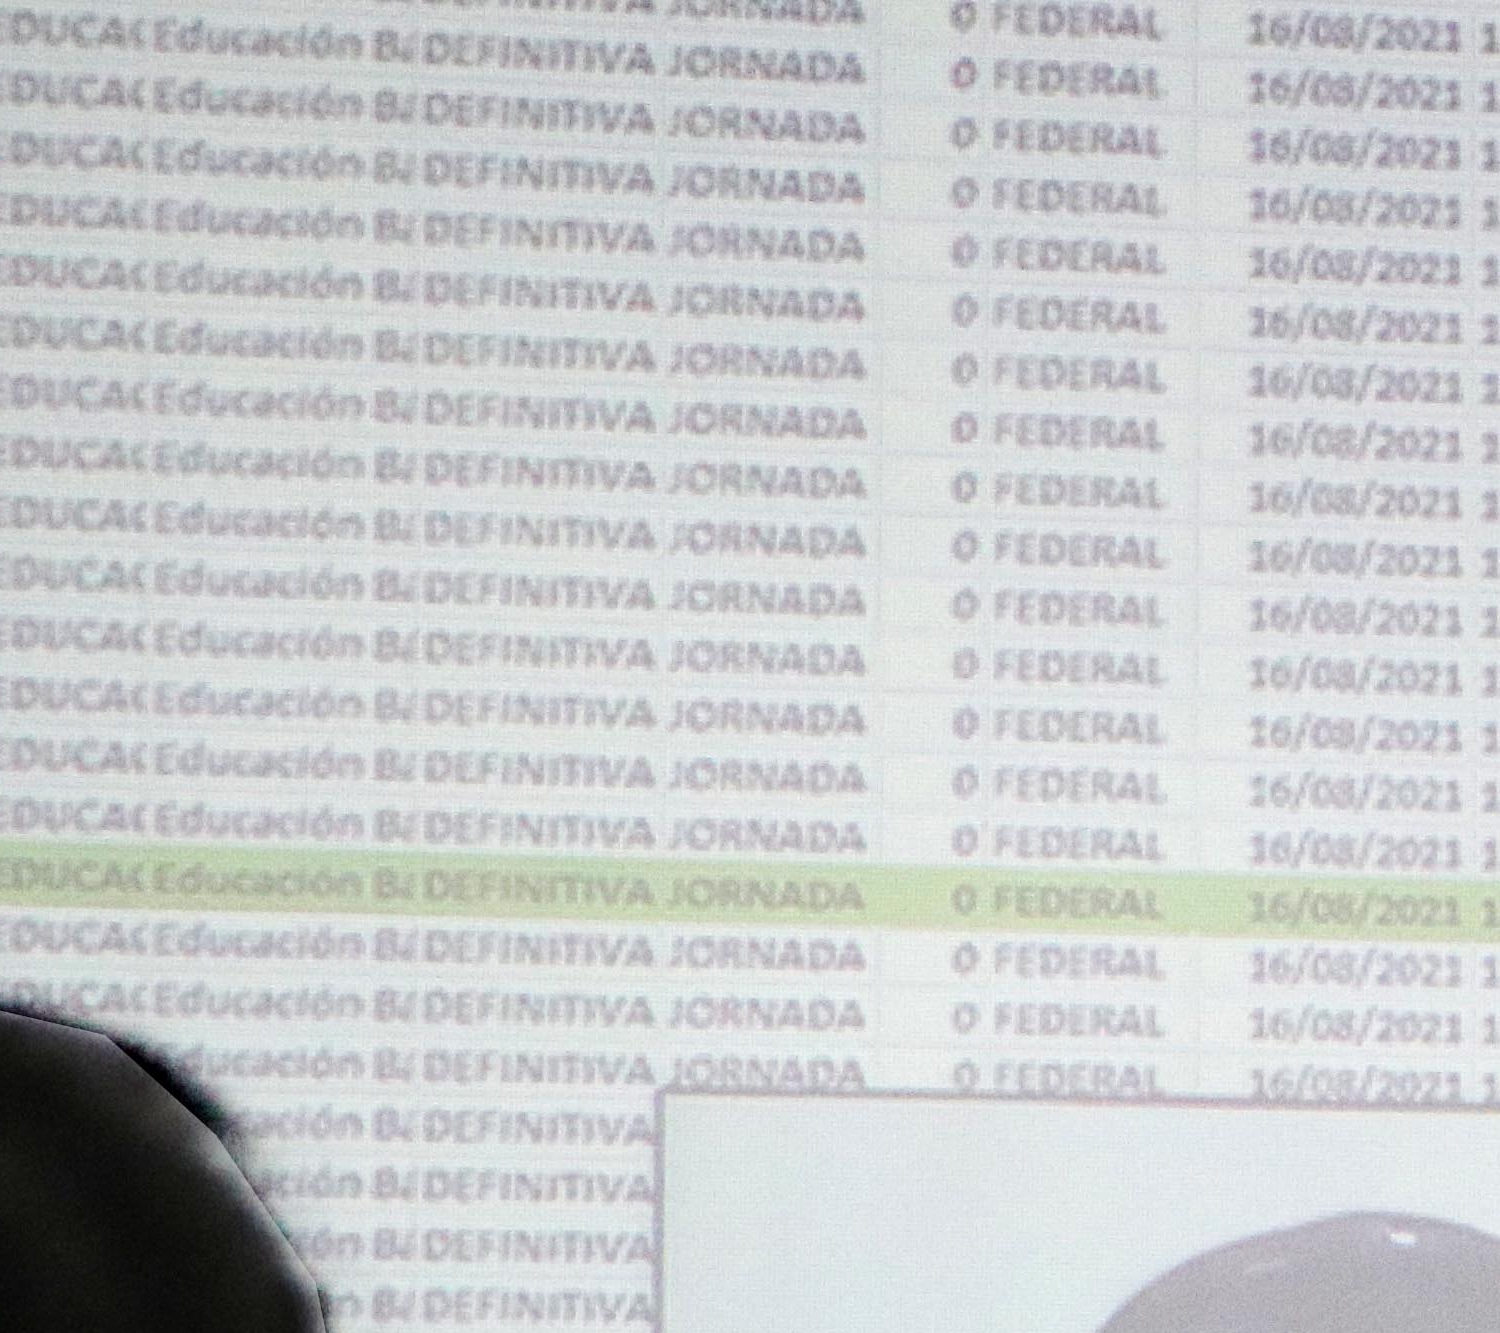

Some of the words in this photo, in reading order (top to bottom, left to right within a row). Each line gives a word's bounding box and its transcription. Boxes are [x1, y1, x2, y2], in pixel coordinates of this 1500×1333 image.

[148, 136, 367, 182] Educación
[421, 149, 658, 195] DEFINITIVA
[667, 162, 867, 204] JORNADA
[992, 176, 1163, 218] FEDERAL
[1248, 184, 1463, 231] 16/08/2021
[151, 498, 366, 542] Educación
[422, 507, 659, 552] DEFINITIVA
[669, 519, 868, 560] JORNADA
[993, 529, 1165, 571] FEDERAL
[1248, 535, 1464, 580] 16/08/2021
[422, 869, 655, 911] DEFINITIVA
[667, 876, 867, 915] JORNADA
[1248, 888, 1464, 930] 16/08/2021
[143, 920, 366, 961] Educación
[421, 927, 657, 967] DEFINITIVA
[668, 934, 867, 973] JORNADA
[993, 940, 1164, 982] FEDERAL
[1250, 945, 1463, 990] 16/08/2021
[420, 1161, 660, 1212] DEFINITIVA
[421, 1281, 660, 1331] DEFINITIVA
